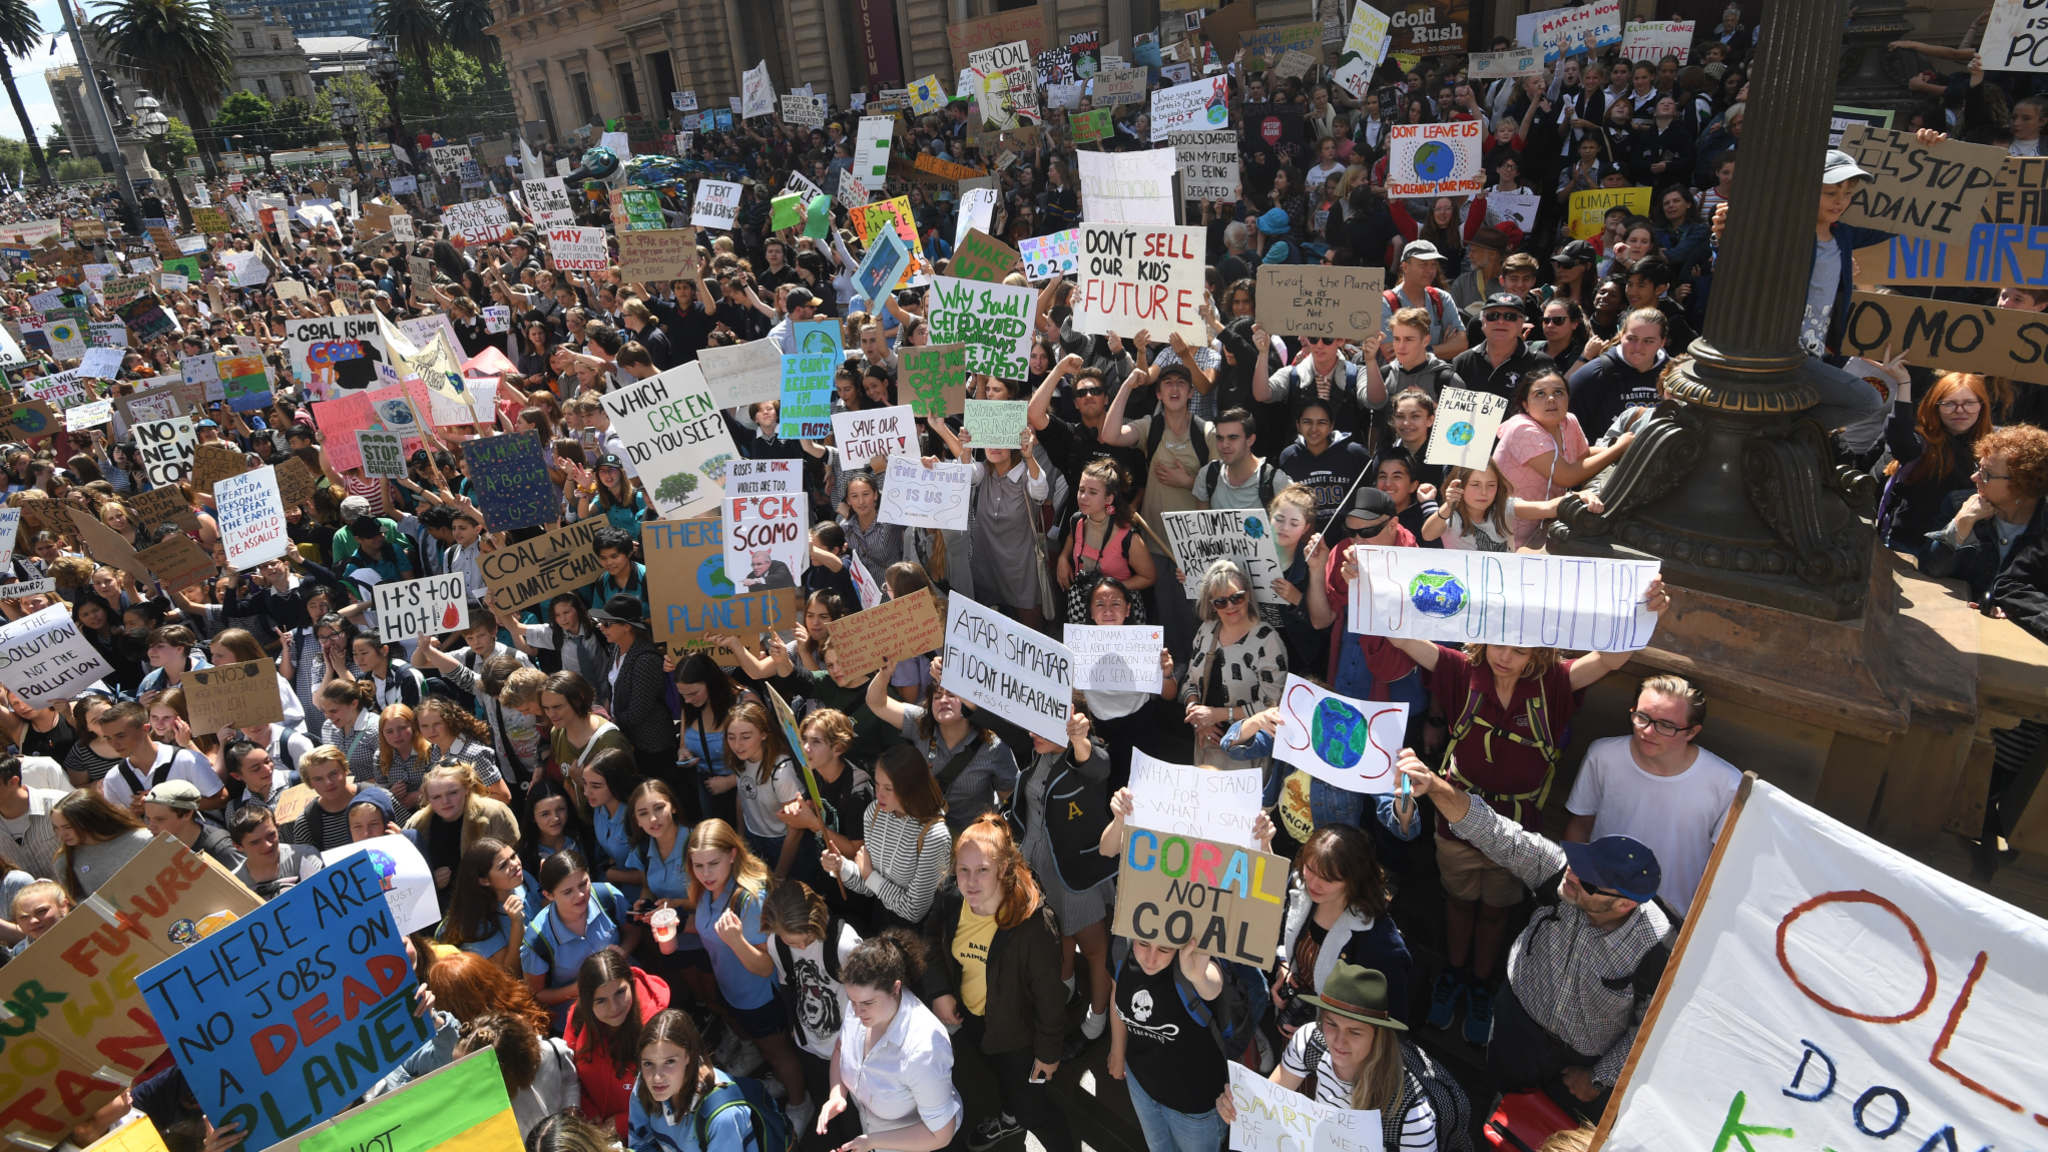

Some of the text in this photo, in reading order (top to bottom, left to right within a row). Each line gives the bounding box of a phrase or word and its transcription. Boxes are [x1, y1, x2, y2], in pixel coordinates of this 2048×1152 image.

[1392, 8, 1435, 27] Gold
[1542, 2, 1620, 33] MARCH NOW
[1412, 23, 1463, 43] Rush
[992, 45, 1029, 69] COAL
[1622, 46, 1690, 61] ATTITUDE
[982, 62, 991, 73] IS
[1167, 112, 1194, 123] HOT
[1392, 122, 1479, 139] DONT LEAVE US
[1187, 165, 1228, 178] IS BEING
[1900, 149, 1994, 204] STOP
[526, 182, 548, 193] SOON
[552, 189, 565, 200] BE
[706, 184, 733, 198] TEXT
[1187, 185, 1229, 198] DEBATED
[1439, 181, 1457, 192] YOUR
[533, 199, 570, 212] SWIMMING
[852, 198, 910, 220] SYSTEM
[1575, 192, 1635, 209] CLIMATE
[449, 213, 511, 232] IF BE LESS
[1849, 191, 1962, 234] ADANI
[463, 225, 501, 242] SHIT
[550, 230, 582, 243] WHY
[1086, 229, 1194, 259] DON'T SELL
[967, 233, 1014, 272] WAKE
[955, 256, 995, 281] UP
[1091, 257, 1122, 277] OUR
[103, 281, 150, 295] SOLUTION
[1265, 270, 1382, 292] Treat the Planet
[934, 280, 1030, 318] Why Should I
[1084, 279, 1192, 326] FUTURE
[1293, 298, 1340, 308] EARTH
[297, 321, 357, 342] COAL IS
[930, 309, 1027, 338] GET EDUCATED
[1286, 318, 1334, 334] Uranus
[904, 348, 966, 373] LIKE THE
[30, 378, 54, 390] WE
[784, 376, 830, 392] BELIEVE
[909, 370, 966, 389] OCEAN
[33, 384, 72, 401] SUFFER
[607, 378, 669, 419] WHICH
[1449, 388, 1508, 410] THERE IS NO
[647, 391, 714, 433] GREEN
[911, 399, 947, 418] RISE
[1444, 400, 1477, 413] PLANET
[136, 421, 176, 446] NO
[801, 422, 830, 437] FACTS
[851, 416, 899, 439] SAVE OUR
[142, 438, 196, 464] NEW
[474, 439, 533, 463] WHAT
[627, 413, 724, 466] DO YOU SEE?
[362, 444, 400, 462] STOP
[368, 465, 404, 475] CHANGE
[485, 468, 546, 491] ABOUT
[733, 462, 767, 476] ROSES ARE
[894, 465, 966, 484] THE FUTURE
[233, 475, 249, 487] WE
[216, 483, 254, 503] TREATED
[218, 488, 271, 514] PERSON LIKE
[905, 488, 942, 504] IS US
[220, 499, 266, 522] WE TREAT
[222, 506, 275, 533] THE EARTH
[508, 501, 538, 521] US
[224, 516, 279, 545] IT WOULD
[646, 521, 723, 550] THERE
[733, 522, 798, 552] SCOMO
[1165, 510, 1243, 541] THE CLIMATE
[229, 527, 280, 558] BE ASSAULT
[482, 520, 603, 580] COAL MINE
[1177, 537, 1258, 561] IS WHY
[2, 581, 44, 597] BACKWARDS
[494, 566, 559, 611] CLIMATE
[667, 593, 782, 635] PLANET B
[1519, 556, 1658, 652] FUTURE
[21, 613, 50, 631] THE
[953, 608, 1070, 687] ATAR SHMATAR
[22, 649, 79, 679] NOT THE
[17, 657, 101, 699] POLLUTION
[942, 643, 1068, 721] IF DONT HAVE A PLANET
[1136, 765, 1259, 794] WHAT STAND
[1173, 788, 1199, 803] FOR
[1067, 802, 1083, 820] A
[1149, 799, 1199, 819] WHAT
[1127, 829, 1281, 905] CORAL
[1165, 879, 1233, 913] NOT
[60, 847, 207, 978] FUTURE
[143, 854, 384, 1022] THERE ARE
[1132, 902, 1264, 965] COAL
[61, 953, 140, 1039] WE
[177, 910, 390, 1065] NO JOBS ON
[218, 954, 408, 1107] A DEAD
[217, 982, 430, 1152] PLANET
[1232, 1084, 1317, 1137] SMART
[1265, 1082, 1357, 1130] YOU WERE
[1241, 1114, 1264, 1132] BE
